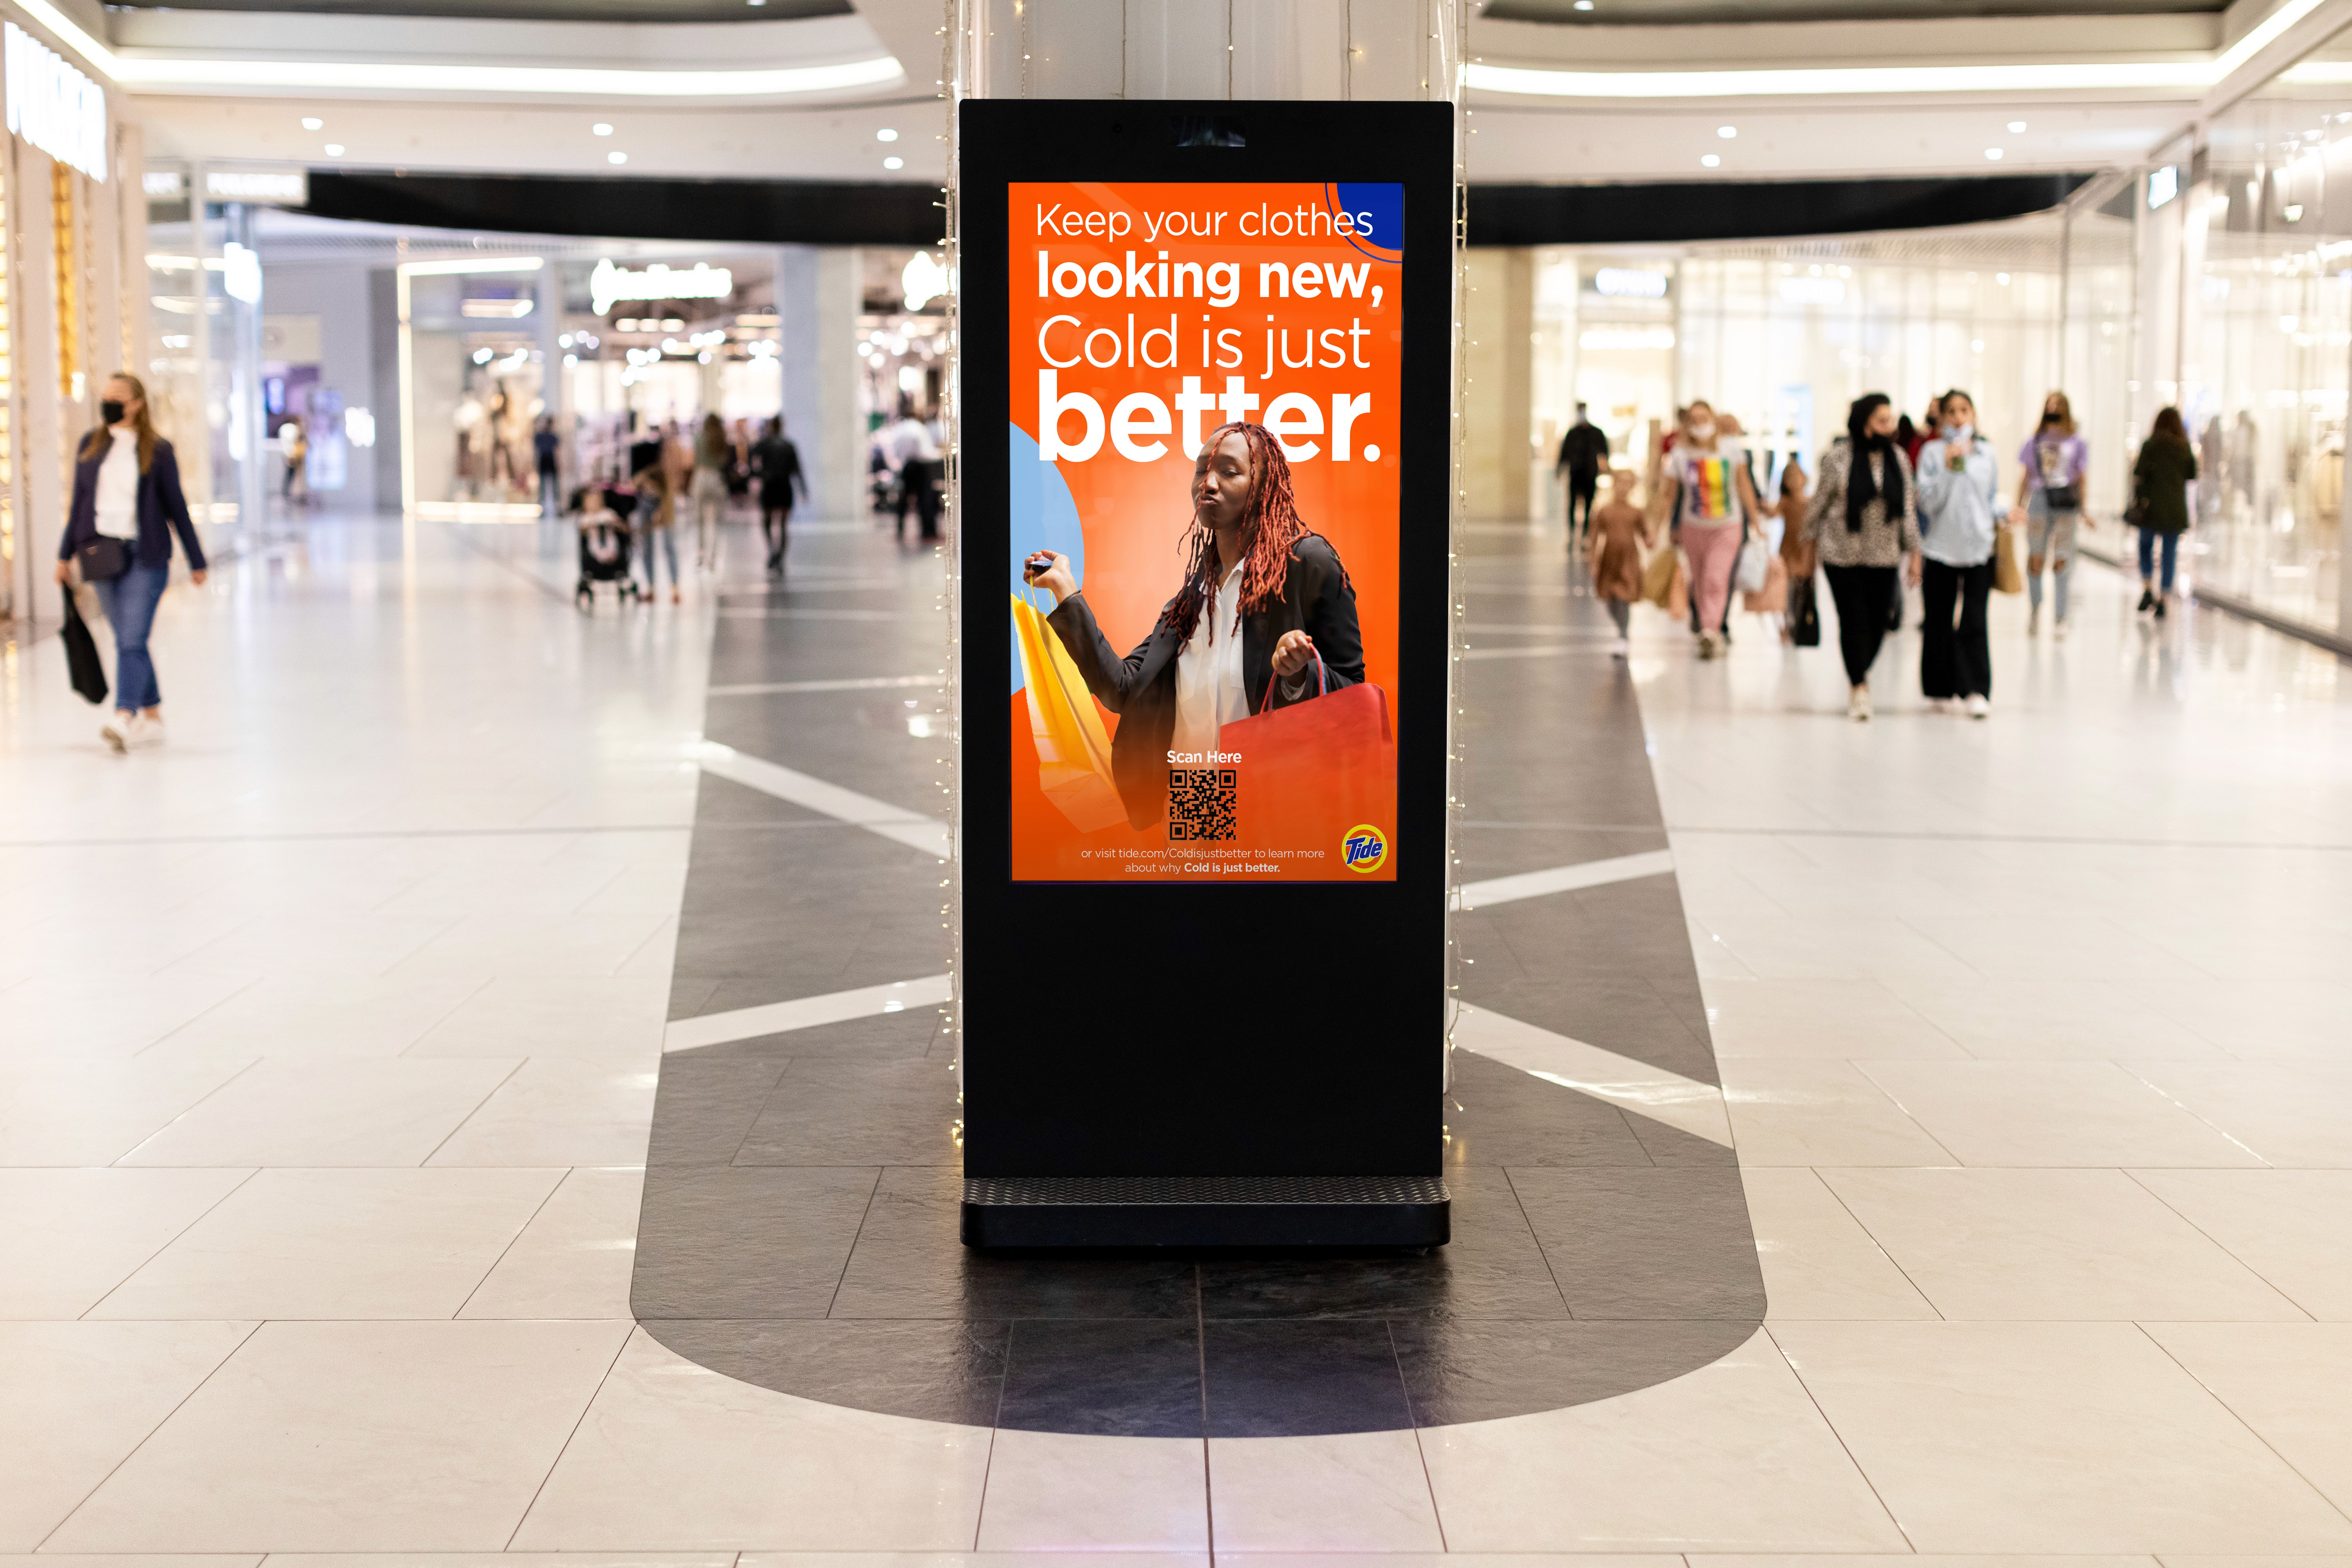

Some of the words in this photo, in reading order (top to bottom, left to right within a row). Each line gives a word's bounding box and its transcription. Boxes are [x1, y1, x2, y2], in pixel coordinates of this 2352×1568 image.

[1037, 203, 1131, 242] Keep
[1143, 211, 1227, 243] your
[1239, 203, 1373, 236] clothes
[1039, 250, 1240, 307] looking
[1260, 263, 1383, 307] new,
[1038, 314, 1177, 368] Cold
[1203, 314, 1243, 368] is
[1260, 315, 1371, 379] just
[1167, 750, 1202, 763] Scan
[1207, 750, 1242, 763] Here
[1095, 848, 1116, 858] visit
[1119, 847, 1252, 860] tide.com/Coldisjustbetter
[1255, 849, 1266, 858] to
[1269, 848, 1294, 858] learn
[1345, 836, 1383, 865] Tide
[1125, 863, 1156, 872] about
[1159, 863, 1181, 874] why
[1184, 862, 1209, 872] Cold
[1212, 863, 1221, 872] is
[1223, 863, 1243, 874] just
[1245, 863, 1280, 872] better.
